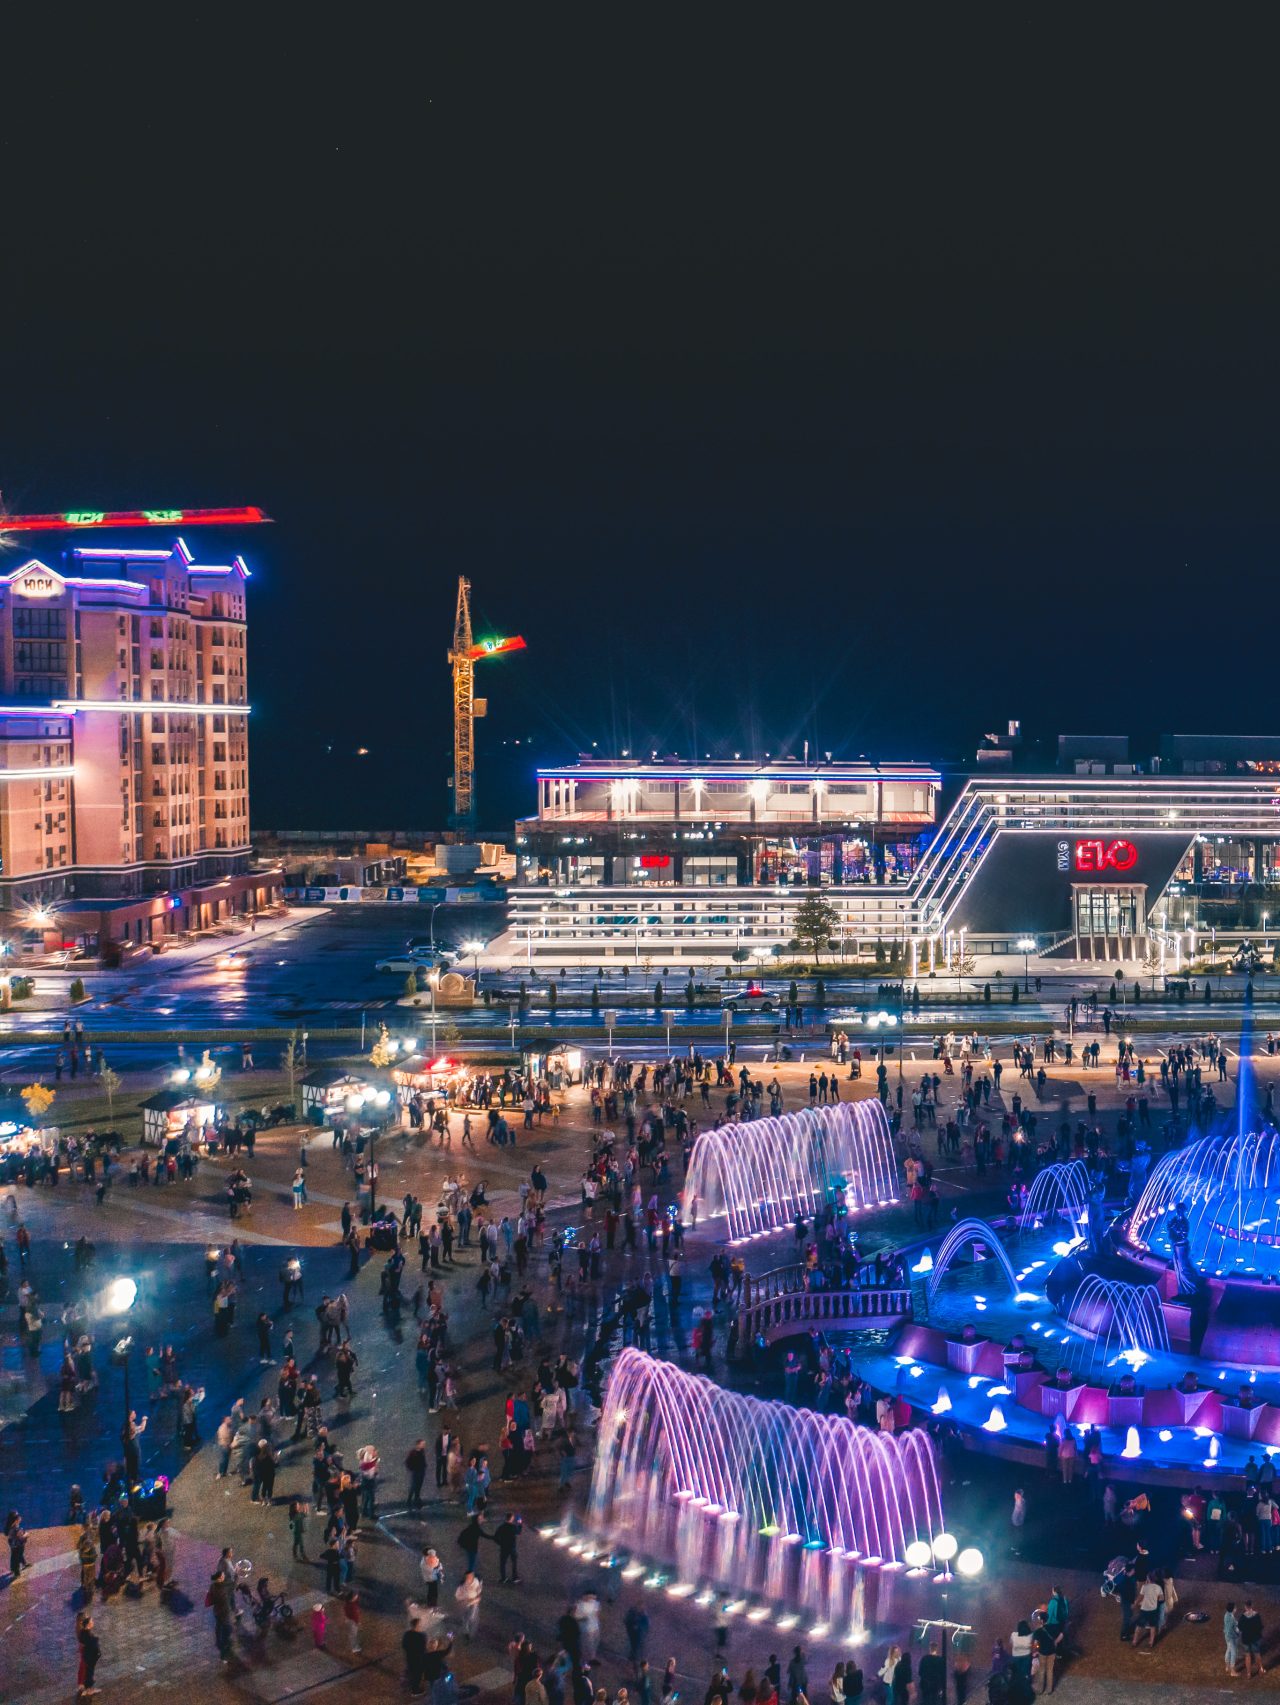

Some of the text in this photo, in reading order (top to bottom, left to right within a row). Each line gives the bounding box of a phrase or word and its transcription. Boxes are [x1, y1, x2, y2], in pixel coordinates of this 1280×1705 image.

[24, 579, 52, 590] ЮСИ
[1057, 840, 1069, 871] GYM
[1075, 839, 1137, 871] EVO
